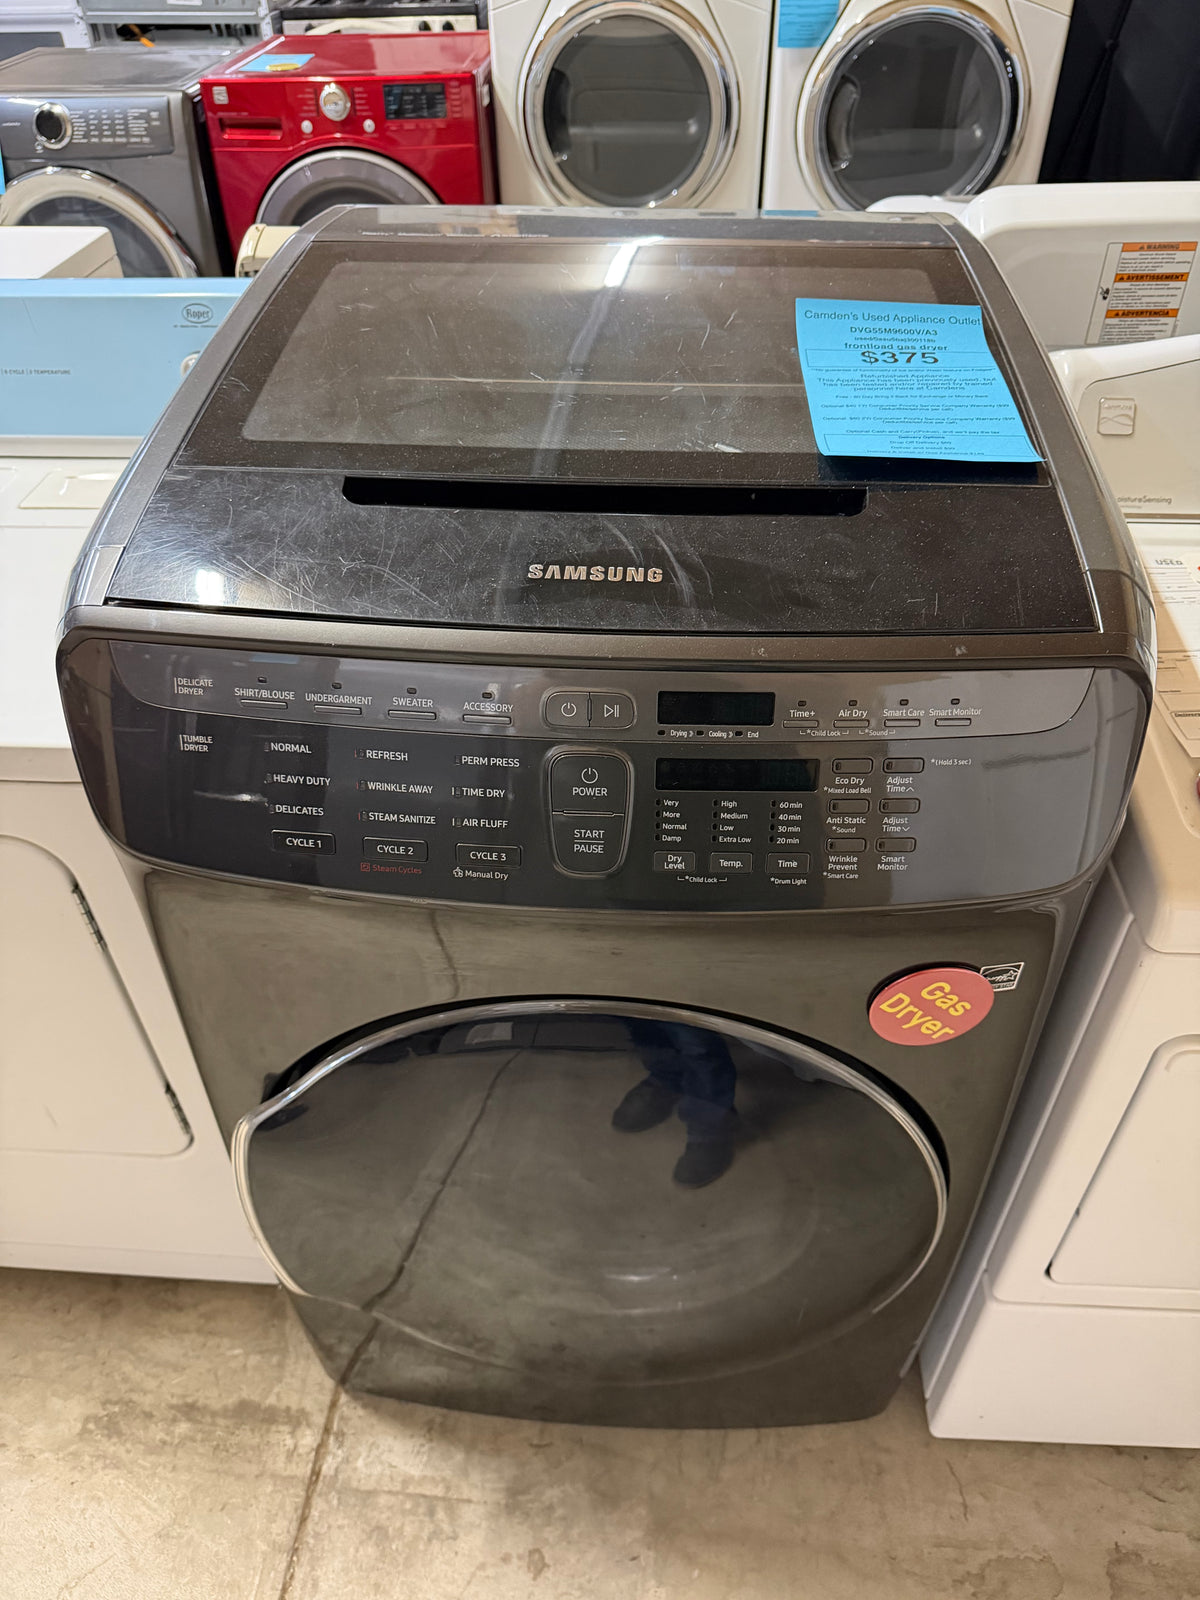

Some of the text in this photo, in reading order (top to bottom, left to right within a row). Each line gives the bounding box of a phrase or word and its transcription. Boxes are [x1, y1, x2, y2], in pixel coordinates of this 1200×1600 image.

[186, 308, 210, 320] Roper
[804, 310, 982, 326] Camden's Used Appliance Outlet
[920, 344, 948, 352] dryer
[861, 350, 939, 365] $375
[1117, 495, 1173, 505] oistureSensing
[527, 563, 664, 583] SAMSUNG
[178, 677, 214, 688] DELICATE
[178, 686, 205, 697] DRYER
[234, 686, 296, 701] SHIRT/BLOUSE
[304, 692, 374, 706] UNDERGARMENT
[392, 696, 434, 708] SWEATER
[463, 701, 514, 713] ACCESSORY
[790, 709, 816, 719] Time+
[838, 709, 868, 720] Air Dry
[883, 708, 926, 717] Smart Care
[929, 708, 982, 717] Smart Monitor
[182, 734, 214, 745] TUMBLE
[670, 730, 688, 738] Drying
[708, 730, 727, 739] Cooling
[184, 743, 210, 753] DRYER
[270, 742, 312, 754] NORMAL
[366, 750, 409, 762] REFRESH
[462, 756, 520, 768] PERM PRESS
[274, 774, 332, 787] HEAVY DUTY
[835, 777, 866, 786] Eco Dry
[886, 776, 914, 786] Adjust
[368, 781, 434, 795] WRINKLE AWAY
[462, 787, 506, 799] TIME DRY
[572, 786, 608, 798] POWER
[886, 785, 906, 793] Time
[663, 800, 680, 808] Very
[720, 800, 738, 810] High
[779, 802, 789, 810] 60
[276, 804, 324, 816] DELICATES
[662, 811, 681, 819] More
[368, 812, 436, 825] STEAM SANITIZE
[720, 812, 749, 820] Medium
[778, 814, 788, 822] 40
[826, 816, 867, 825] Anti Static
[882, 816, 909, 826] Adjust
[462, 818, 510, 829] AIR FLUFF
[662, 822, 688, 831] Normal
[718, 824, 734, 832] Low
[882, 824, 902, 833] Time
[573, 828, 605, 840] START
[777, 826, 787, 834] 30
[286, 837, 322, 849] CYCLE 1
[662, 834, 682, 844] Damp
[718, 836, 752, 844] Extra Low
[776, 837, 786, 845] 20
[376, 844, 414, 856] CYCLE 2
[573, 843, 604, 855] PAUSE
[470, 850, 508, 862] CYCLE 3
[667, 854, 682, 864] Dry
[828, 856, 858, 864] Wrinkle
[881, 856, 906, 864] Smart
[664, 862, 686, 871] Level
[719, 859, 744, 870] Temp.
[778, 860, 798, 869] Time
[828, 863, 858, 872] Prevent
[877, 863, 909, 872] Monitor
[372, 864, 422, 876] Steam Cycles
[465, 870, 510, 882] Manual Dry
[920, 982, 972, 1017] Gas
[878, 992, 956, 1040] Dryer
